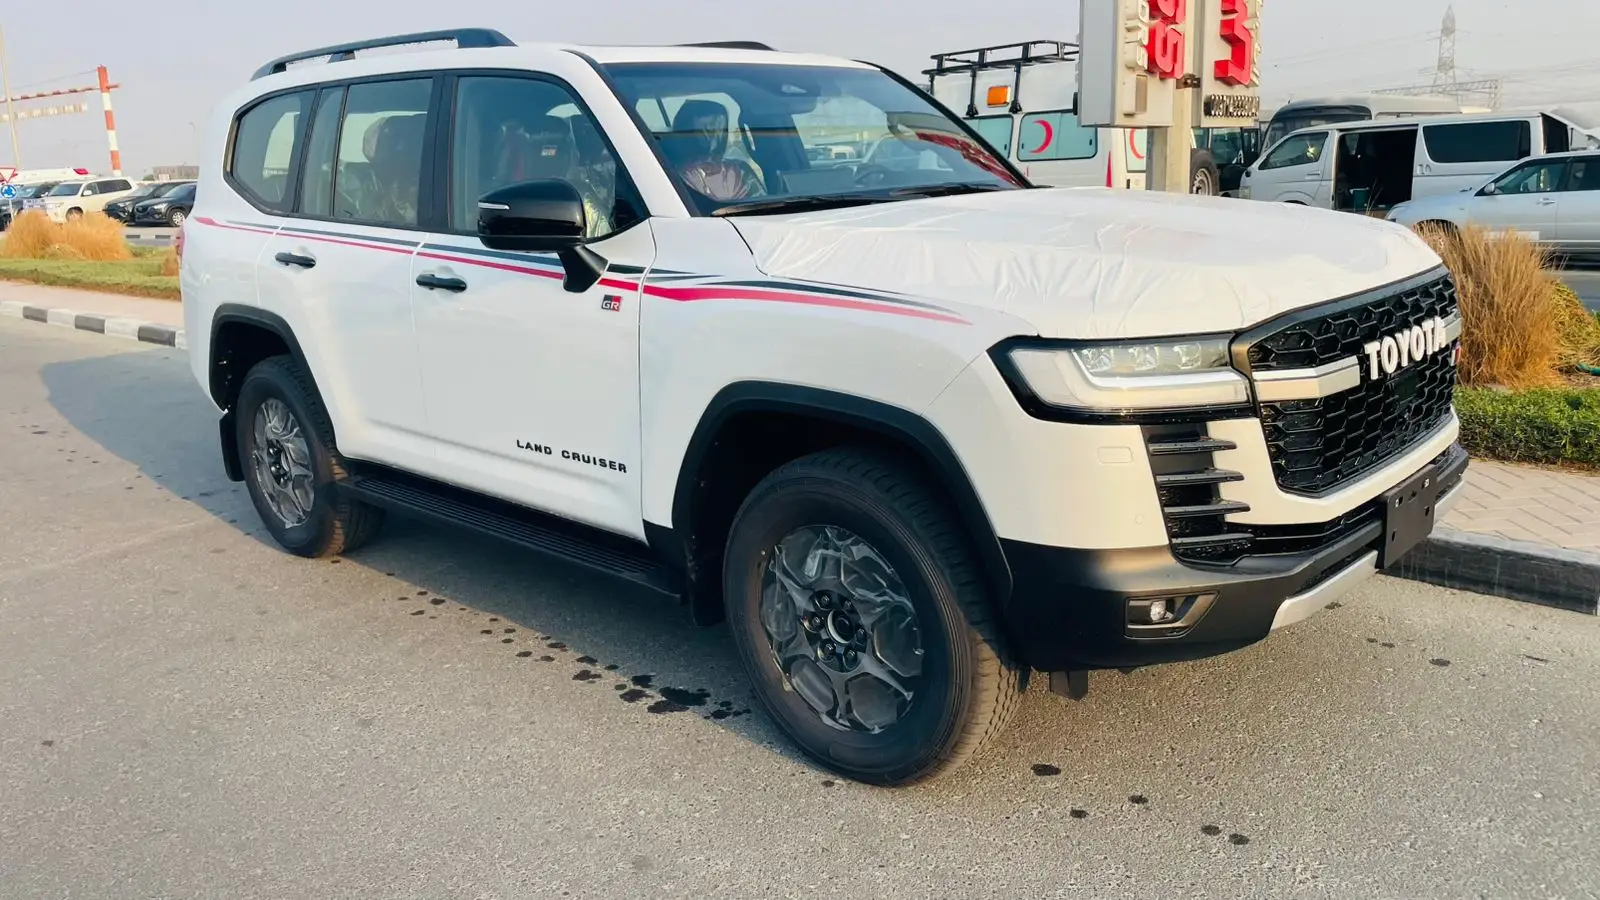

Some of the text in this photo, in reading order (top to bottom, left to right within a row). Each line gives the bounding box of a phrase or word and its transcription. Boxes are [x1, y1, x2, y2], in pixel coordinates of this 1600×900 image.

[602, 299, 621, 311] GR
[1364, 316, 1446, 380] TOYOTA
[516, 439, 627, 473] LAND CRUISER
